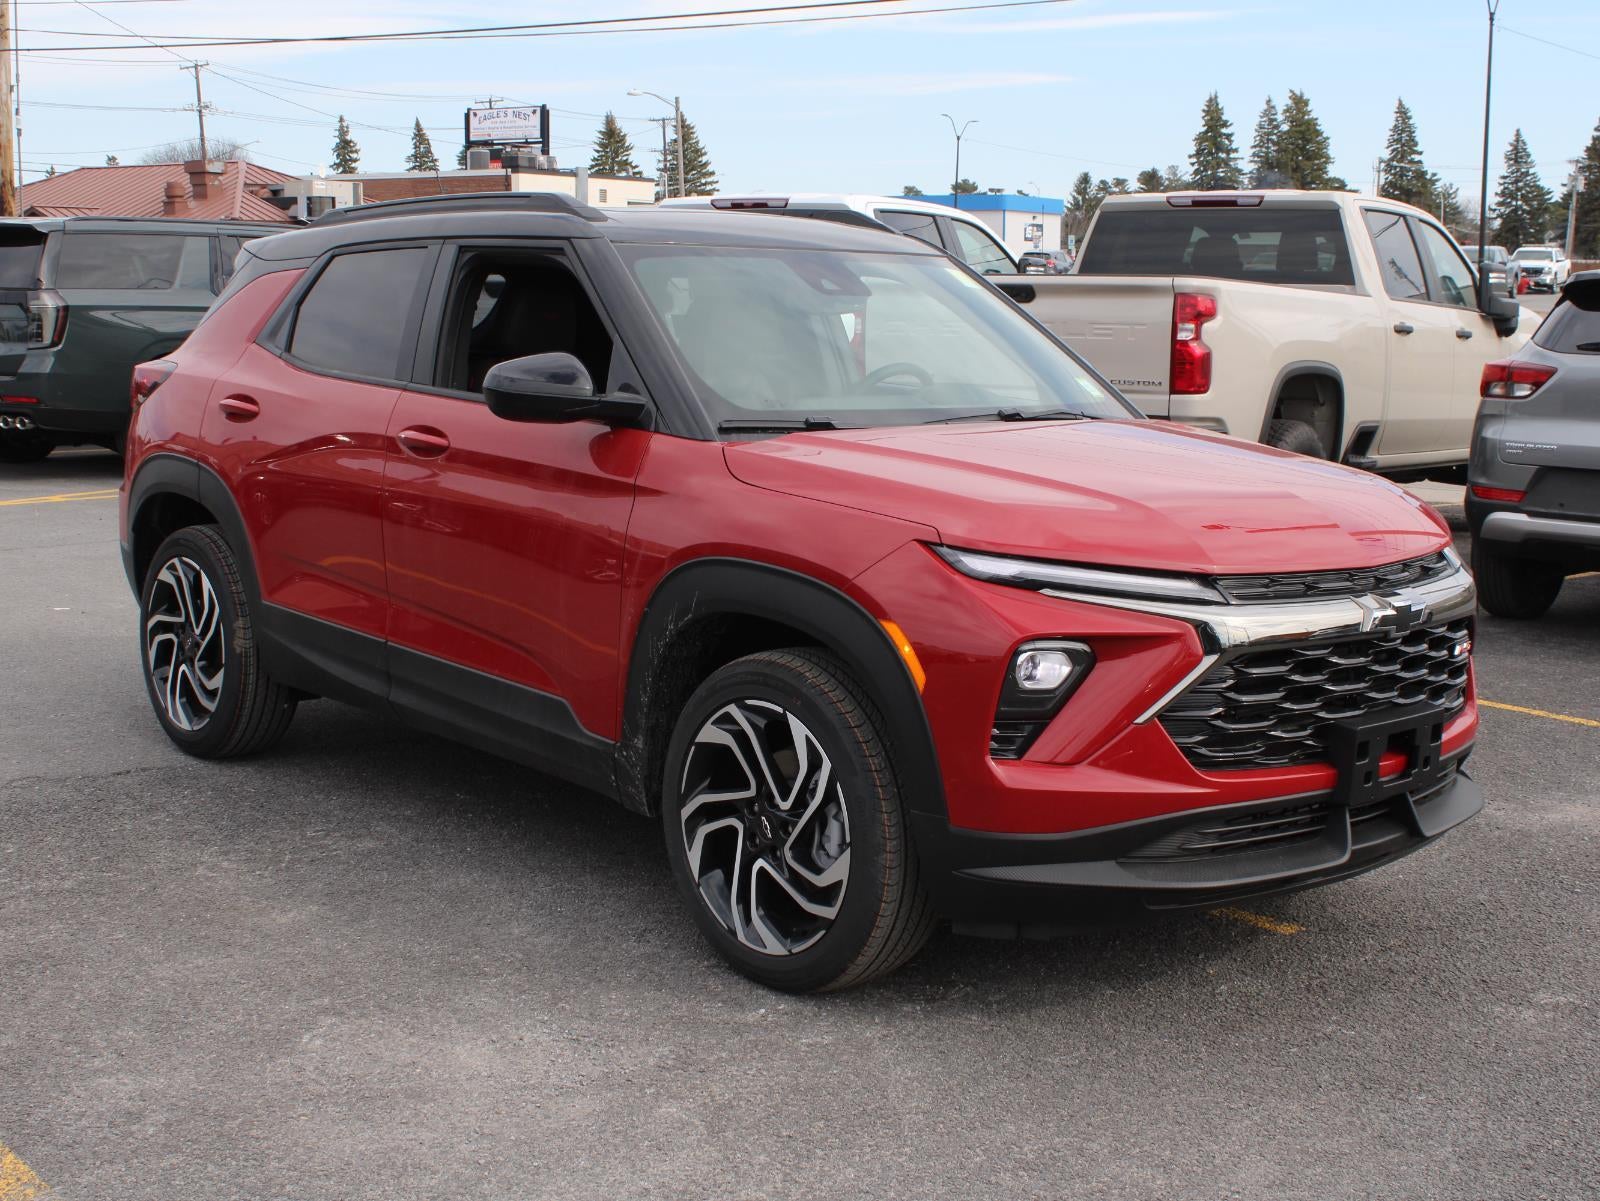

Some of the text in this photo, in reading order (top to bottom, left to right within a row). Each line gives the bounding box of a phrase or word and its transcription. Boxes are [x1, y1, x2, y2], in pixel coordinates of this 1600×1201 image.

[478, 110, 508, 124] EAGLE'S
[512, 110, 531, 122] NEST
[1110, 379, 1163, 387] CUSTOM
